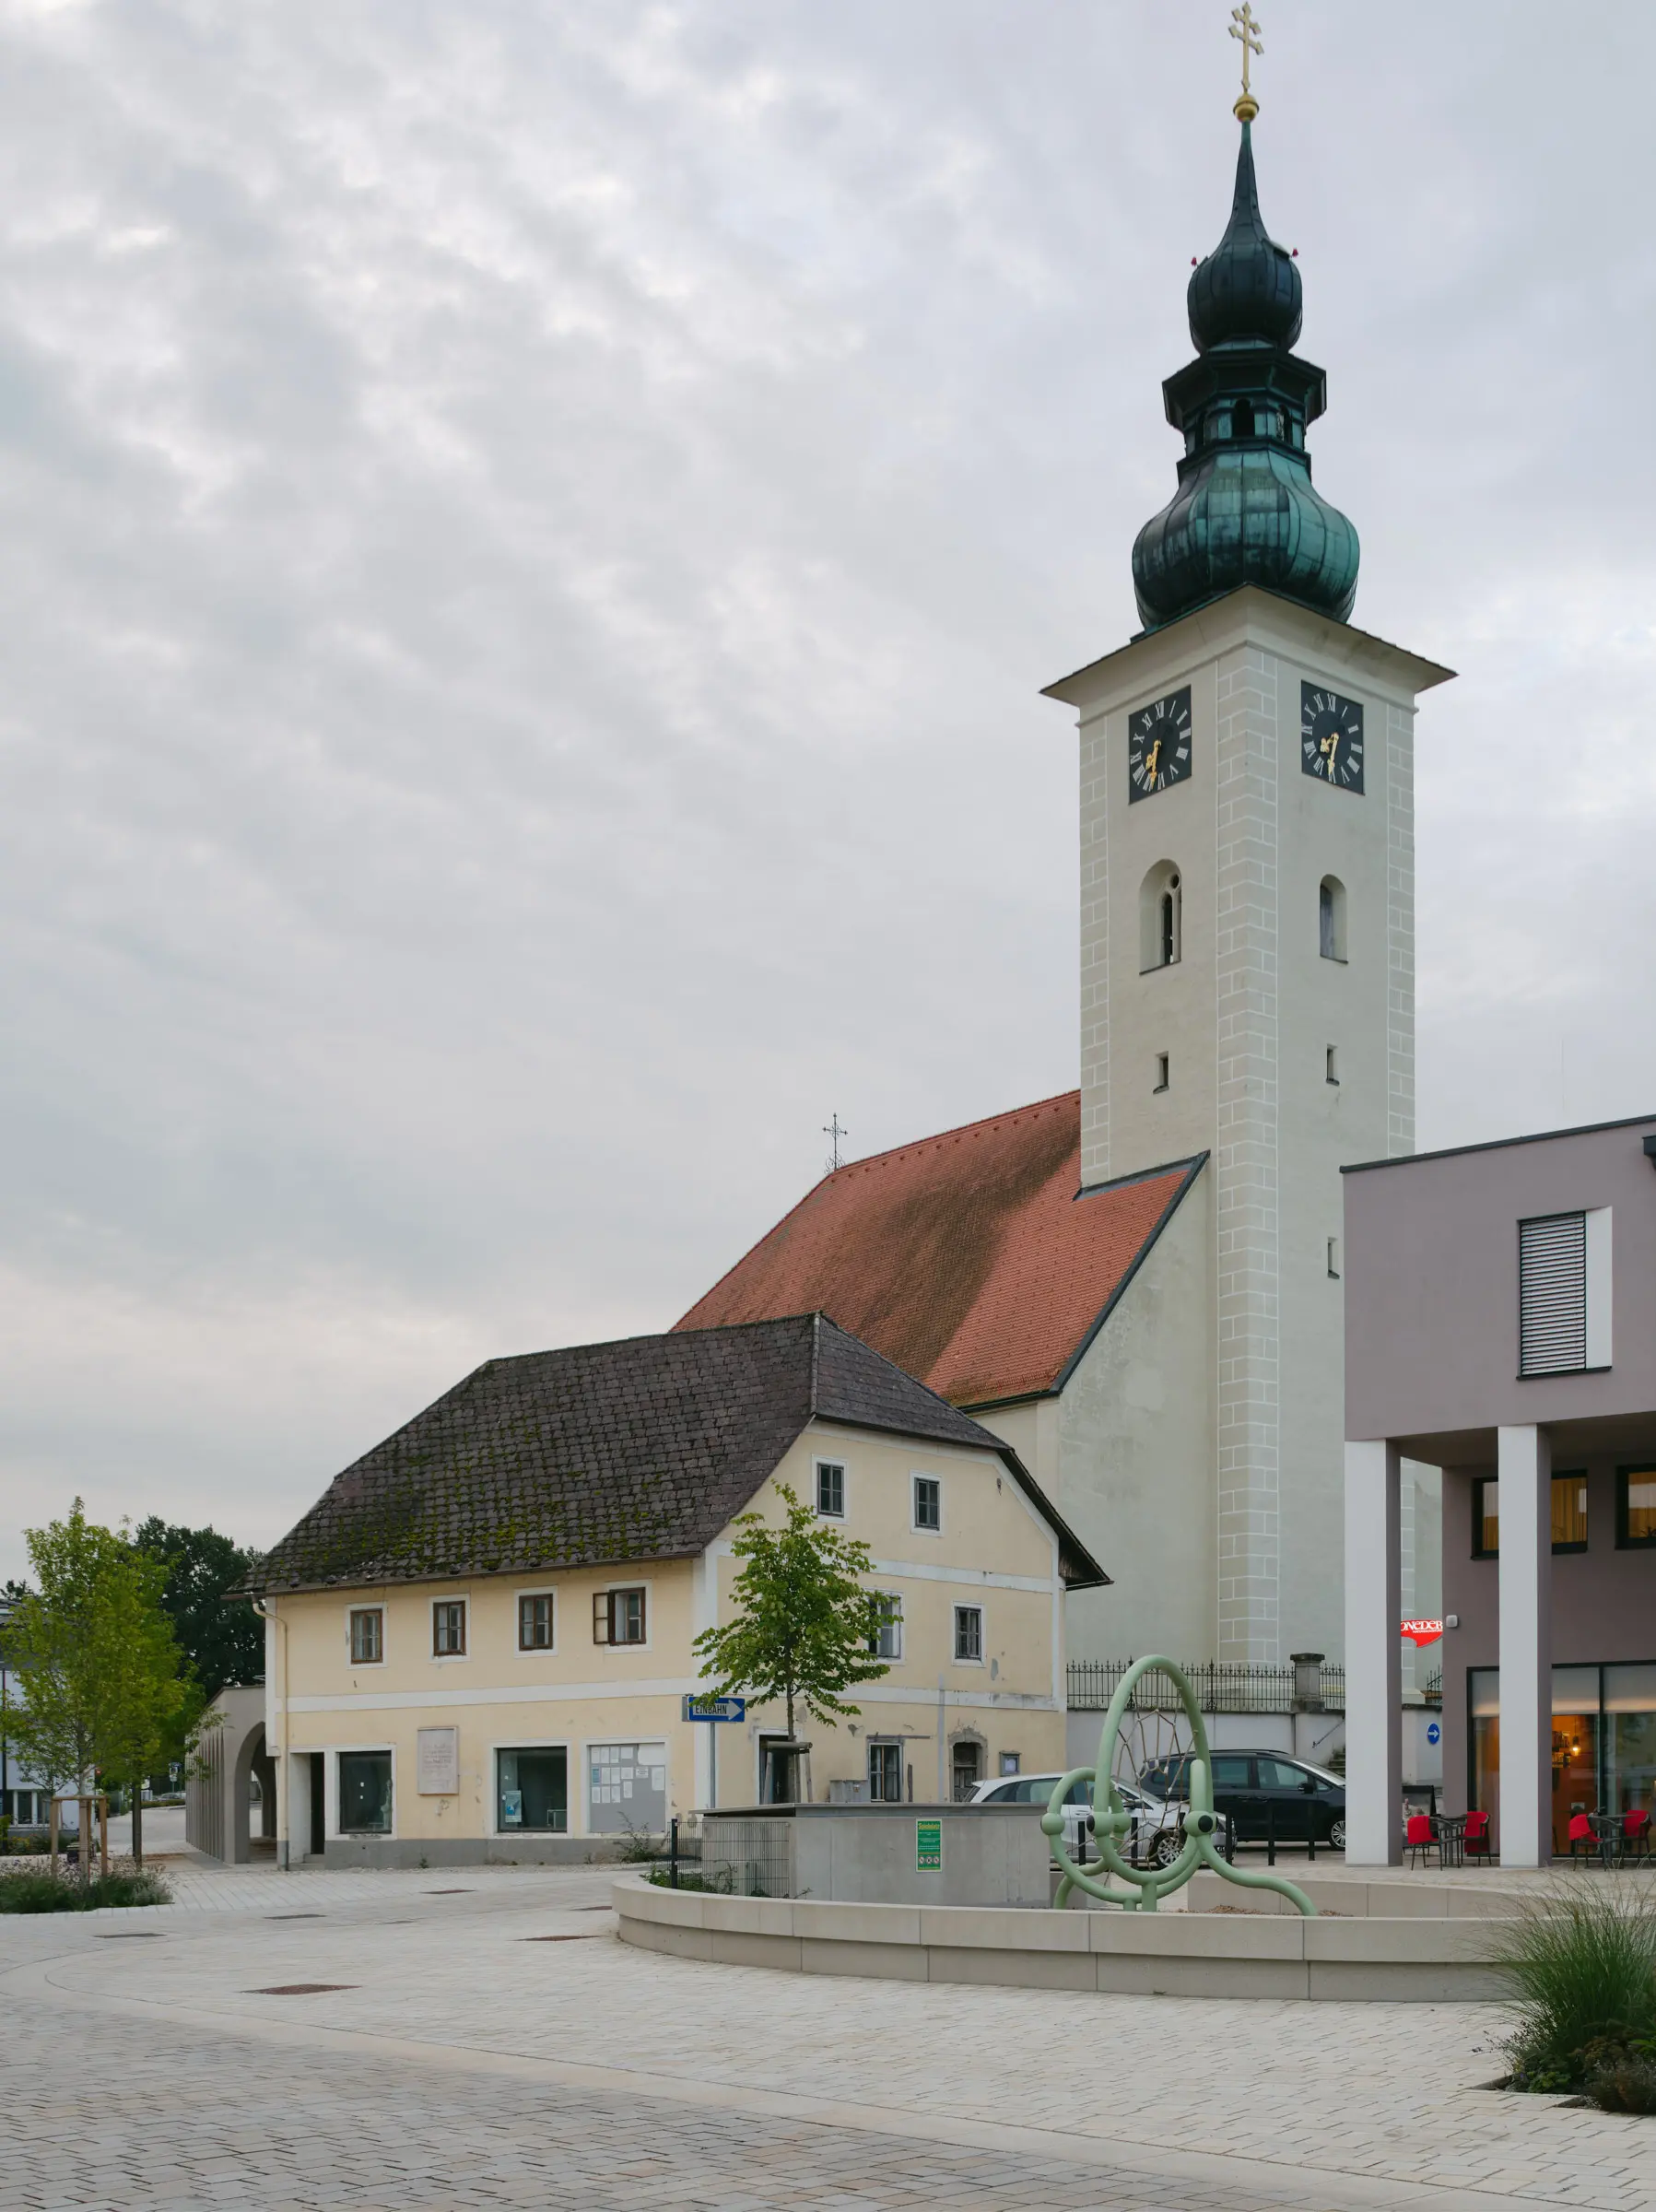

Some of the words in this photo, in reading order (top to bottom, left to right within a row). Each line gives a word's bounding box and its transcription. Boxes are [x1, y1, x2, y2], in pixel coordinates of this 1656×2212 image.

[1155, 700, 1165, 721] XII
[1169, 700, 1177, 718] I
[1313, 692, 1324, 712] XI
[1327, 692, 1336, 712] XII
[1341, 704, 1348, 718] I
[1141, 712, 1153, 731] XI
[1304, 703, 1317, 721] X
[1133, 732, 1145, 744] X
[1301, 723, 1313, 736] IX
[1130, 750, 1142, 765] IX
[1303, 740, 1317, 760] VIII
[1132, 763, 1145, 785] VIII
[1169, 763, 1180, 781] V
[1312, 756, 1324, 776] VII
[1340, 765, 1350, 784] V
[1157, 771, 1166, 791] VI
[695, 1704, 727, 1714] EINBAHN
